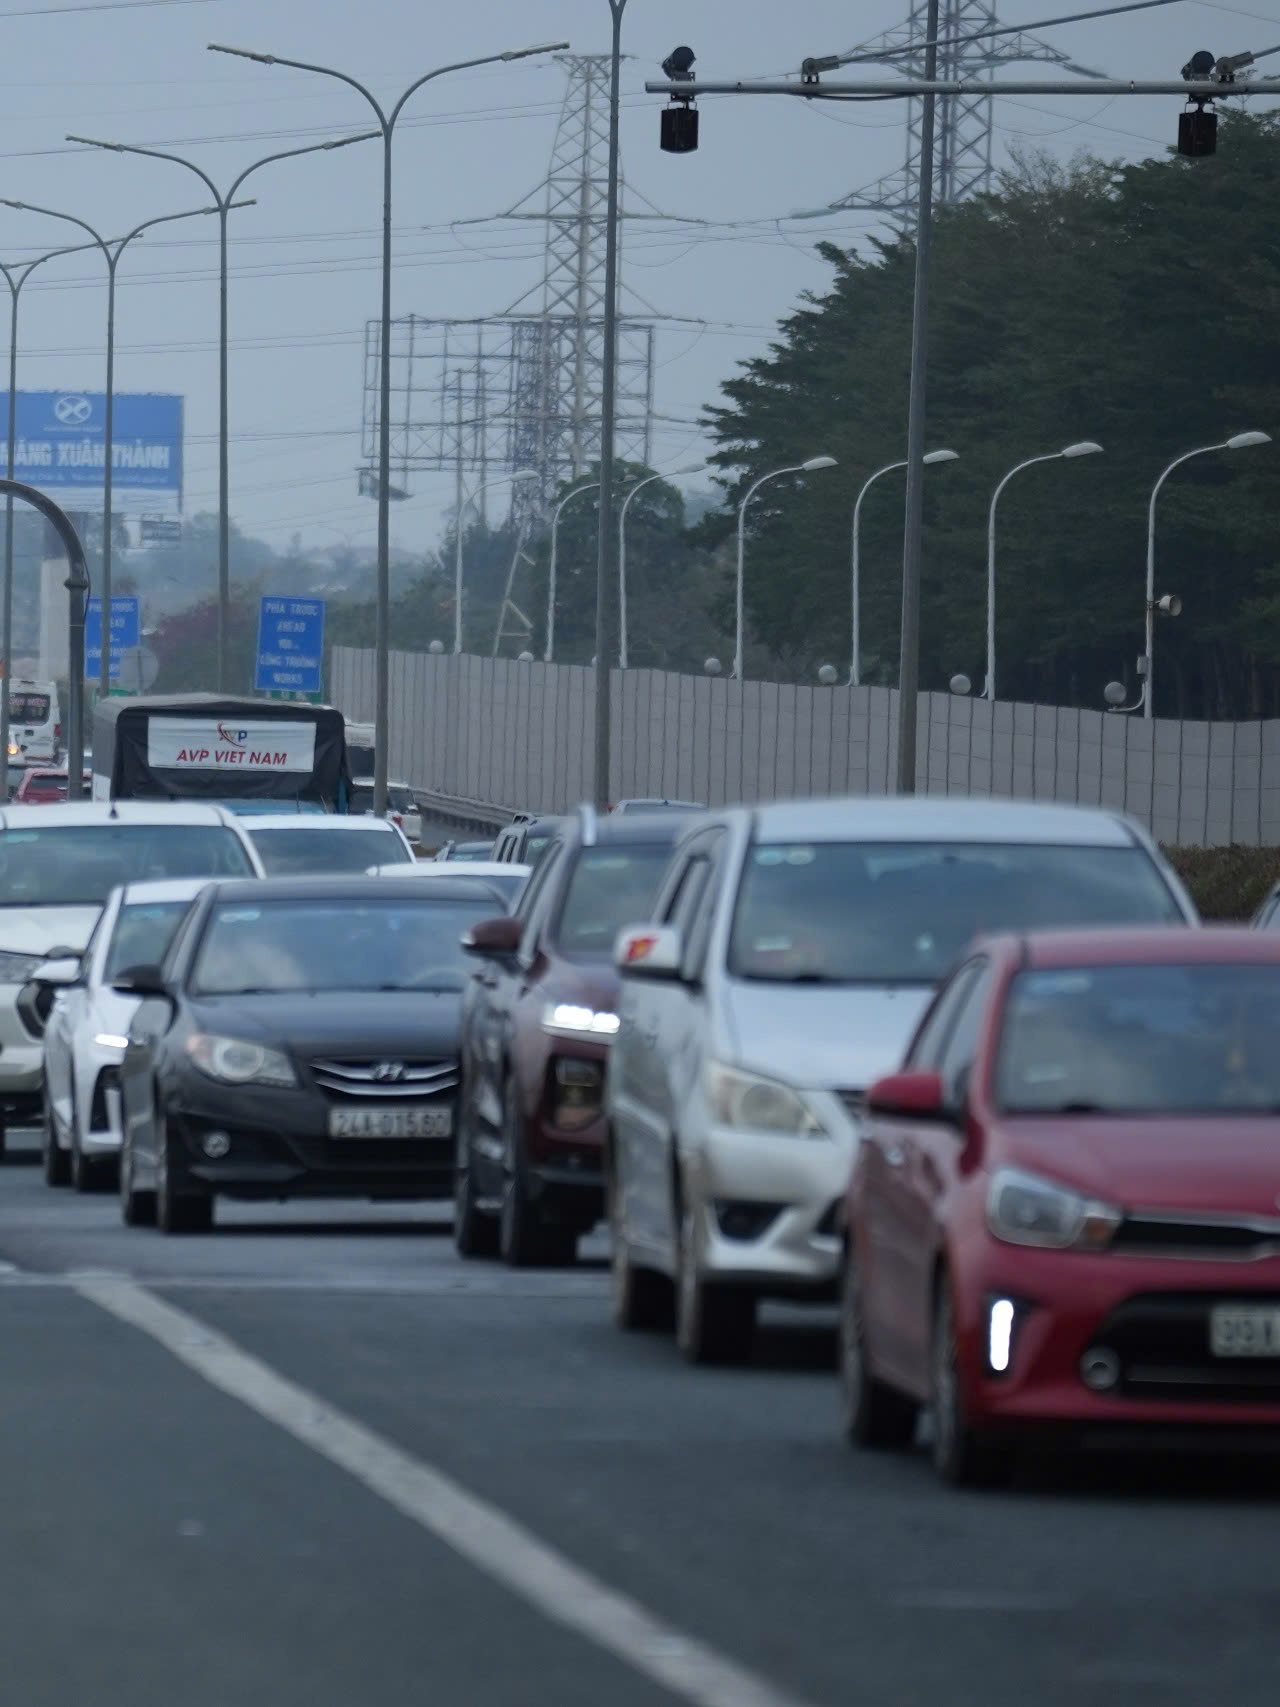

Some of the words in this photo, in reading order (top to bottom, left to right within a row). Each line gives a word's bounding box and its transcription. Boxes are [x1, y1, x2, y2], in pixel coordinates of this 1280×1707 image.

[176, 748, 210, 762] AVP
[214, 749, 246, 764] VIET
[249, 751, 288, 766] NAM
